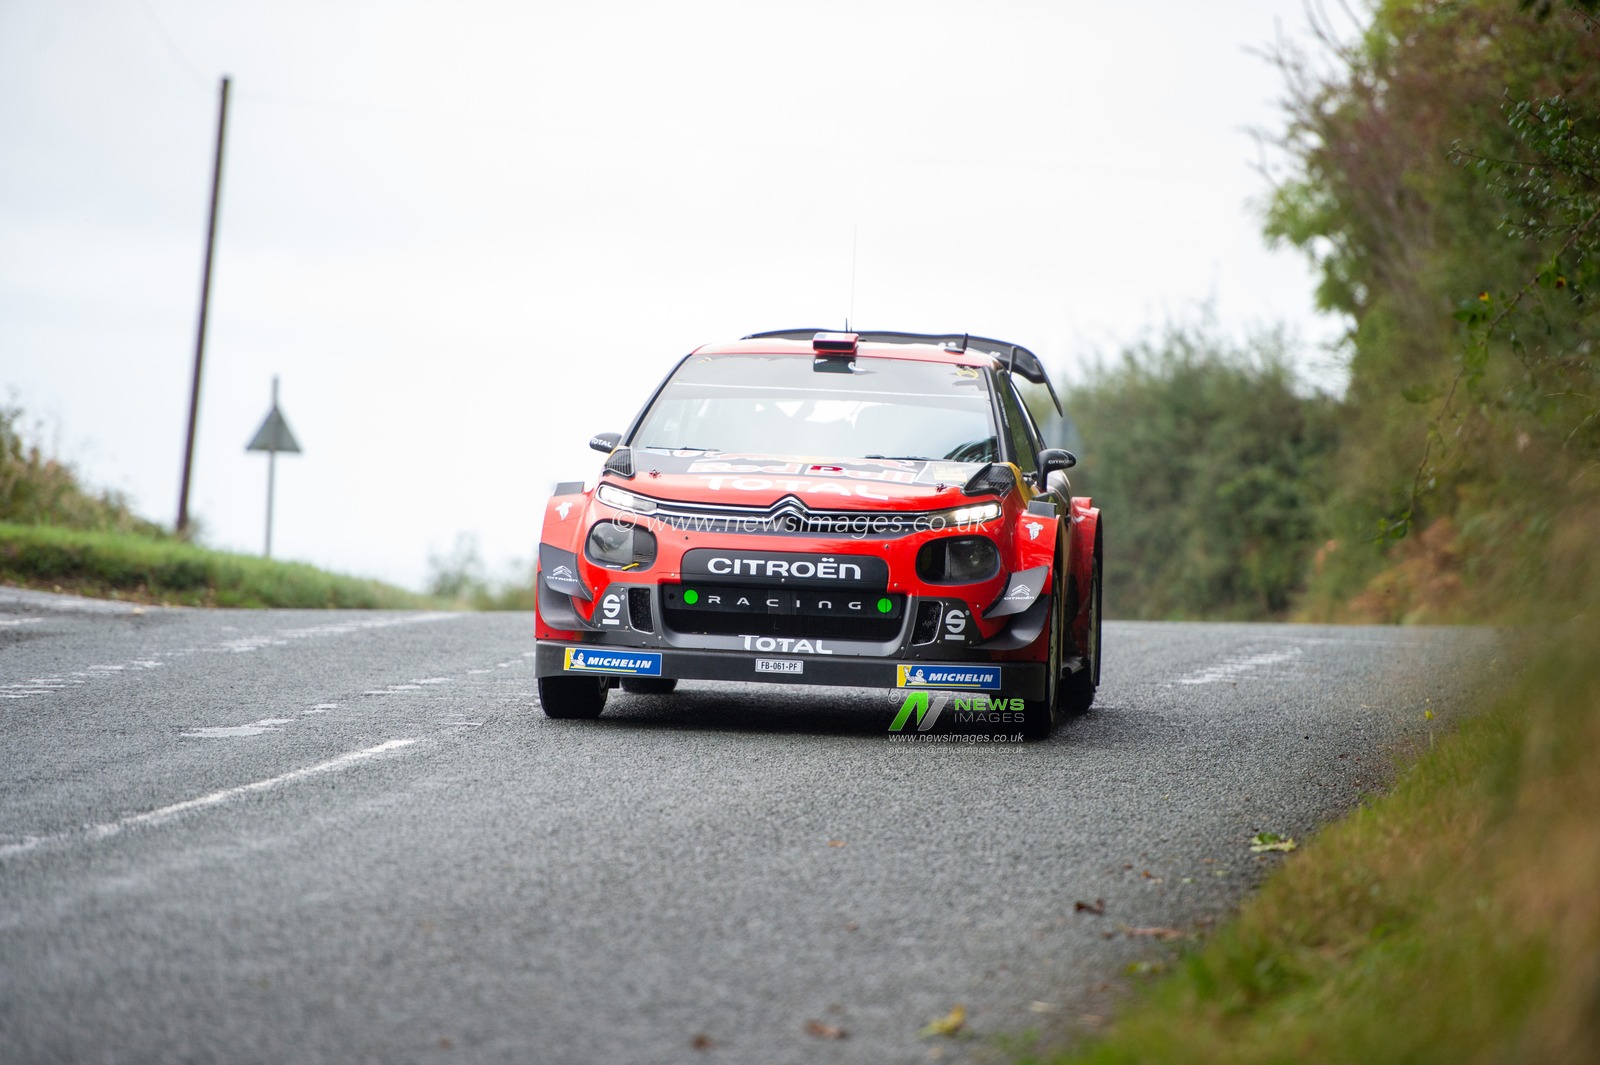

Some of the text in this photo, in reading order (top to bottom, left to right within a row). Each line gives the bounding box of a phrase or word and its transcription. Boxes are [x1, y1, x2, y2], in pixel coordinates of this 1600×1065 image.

[591, 437, 612, 448] TOTAL
[698, 475, 888, 501] TOTAL
[707, 557, 862, 580] CITROËN
[707, 595, 862, 611] RACING
[738, 634, 833, 655] TOTAL
[586, 656, 653, 669] MICHELIN
[760, 660, 798, 671] FB-061-PF
[928, 672, 994, 683] MICHELIN
